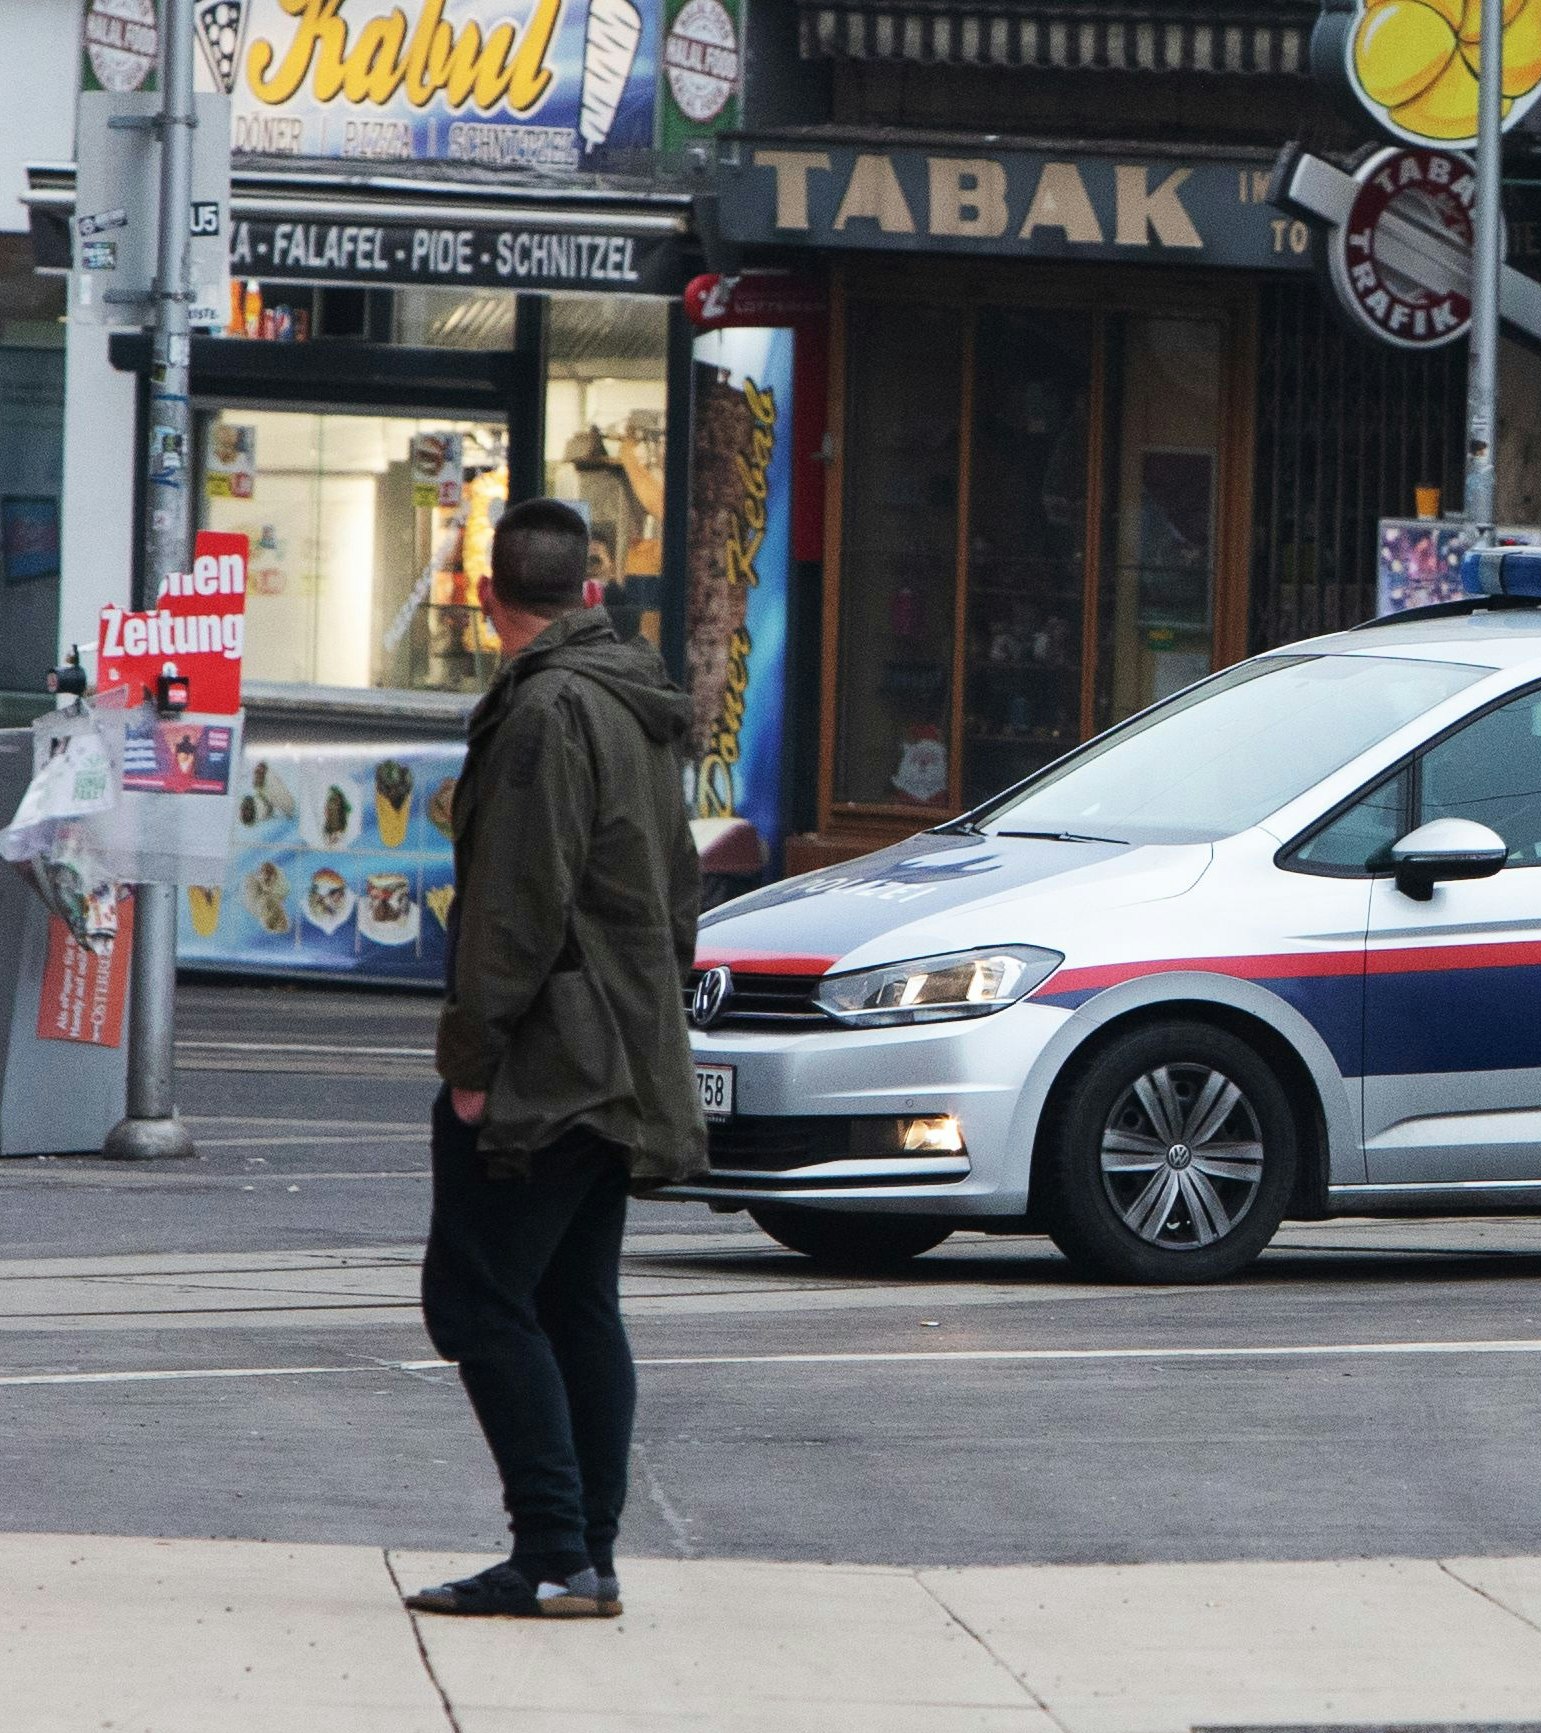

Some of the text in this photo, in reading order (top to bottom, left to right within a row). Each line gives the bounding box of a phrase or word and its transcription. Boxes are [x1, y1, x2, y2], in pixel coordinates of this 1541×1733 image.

[246, 0, 561, 112] Kabul
[754, 150, 1203, 248] TABAK
[1373, 156, 1478, 221] TABA
[273, 222, 388, 271] FALAFEL
[410, 228, 474, 276] PIDE
[496, 232, 639, 281] SCHNITZEL
[1350, 227, 1459, 336] TRAFIK
[697, 375, 777, 819] Döner Kebab
[100, 607, 245, 660] Zeitung
[783, 877, 938, 903] POLIZEI
[697, 1073, 724, 1107] 758
